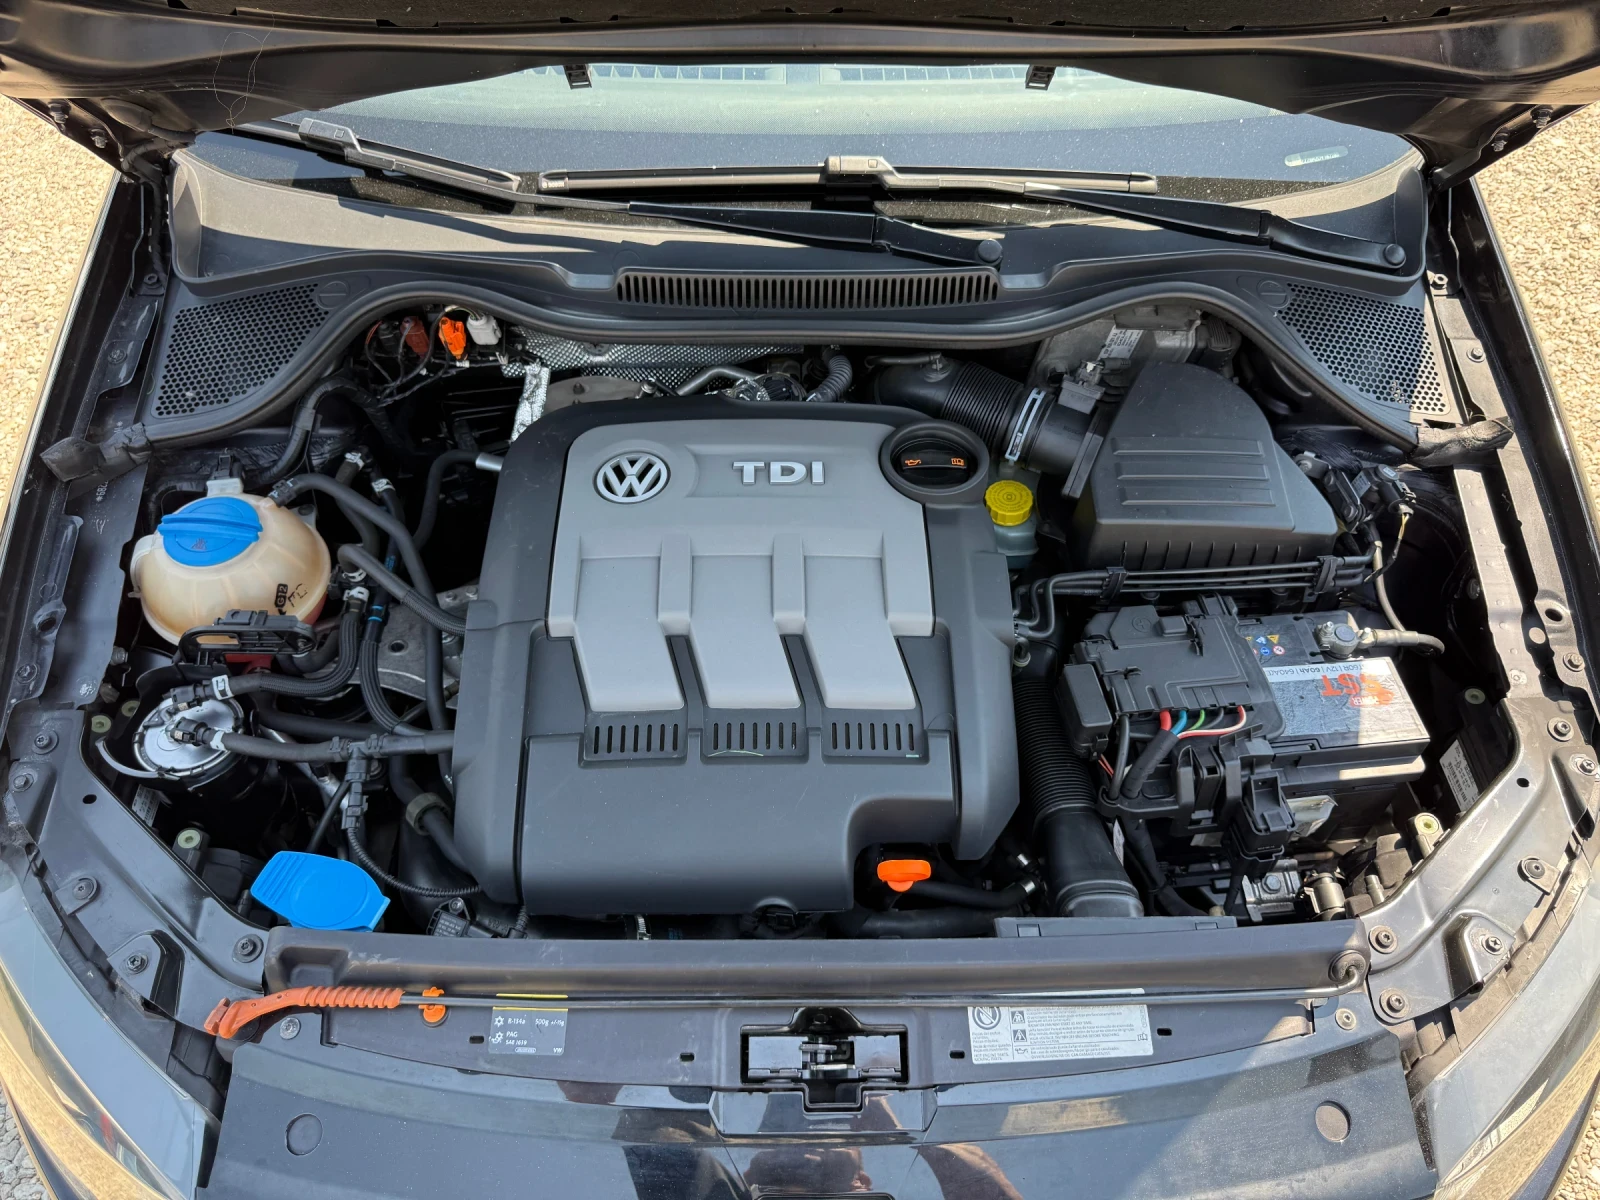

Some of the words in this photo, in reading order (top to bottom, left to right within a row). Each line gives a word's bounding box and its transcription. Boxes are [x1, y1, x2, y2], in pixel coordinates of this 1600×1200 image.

[733, 461, 825, 485] TDI
[1299, 667, 1321, 675] 60Ah
[535, 1018, 549, 1027] 500g
